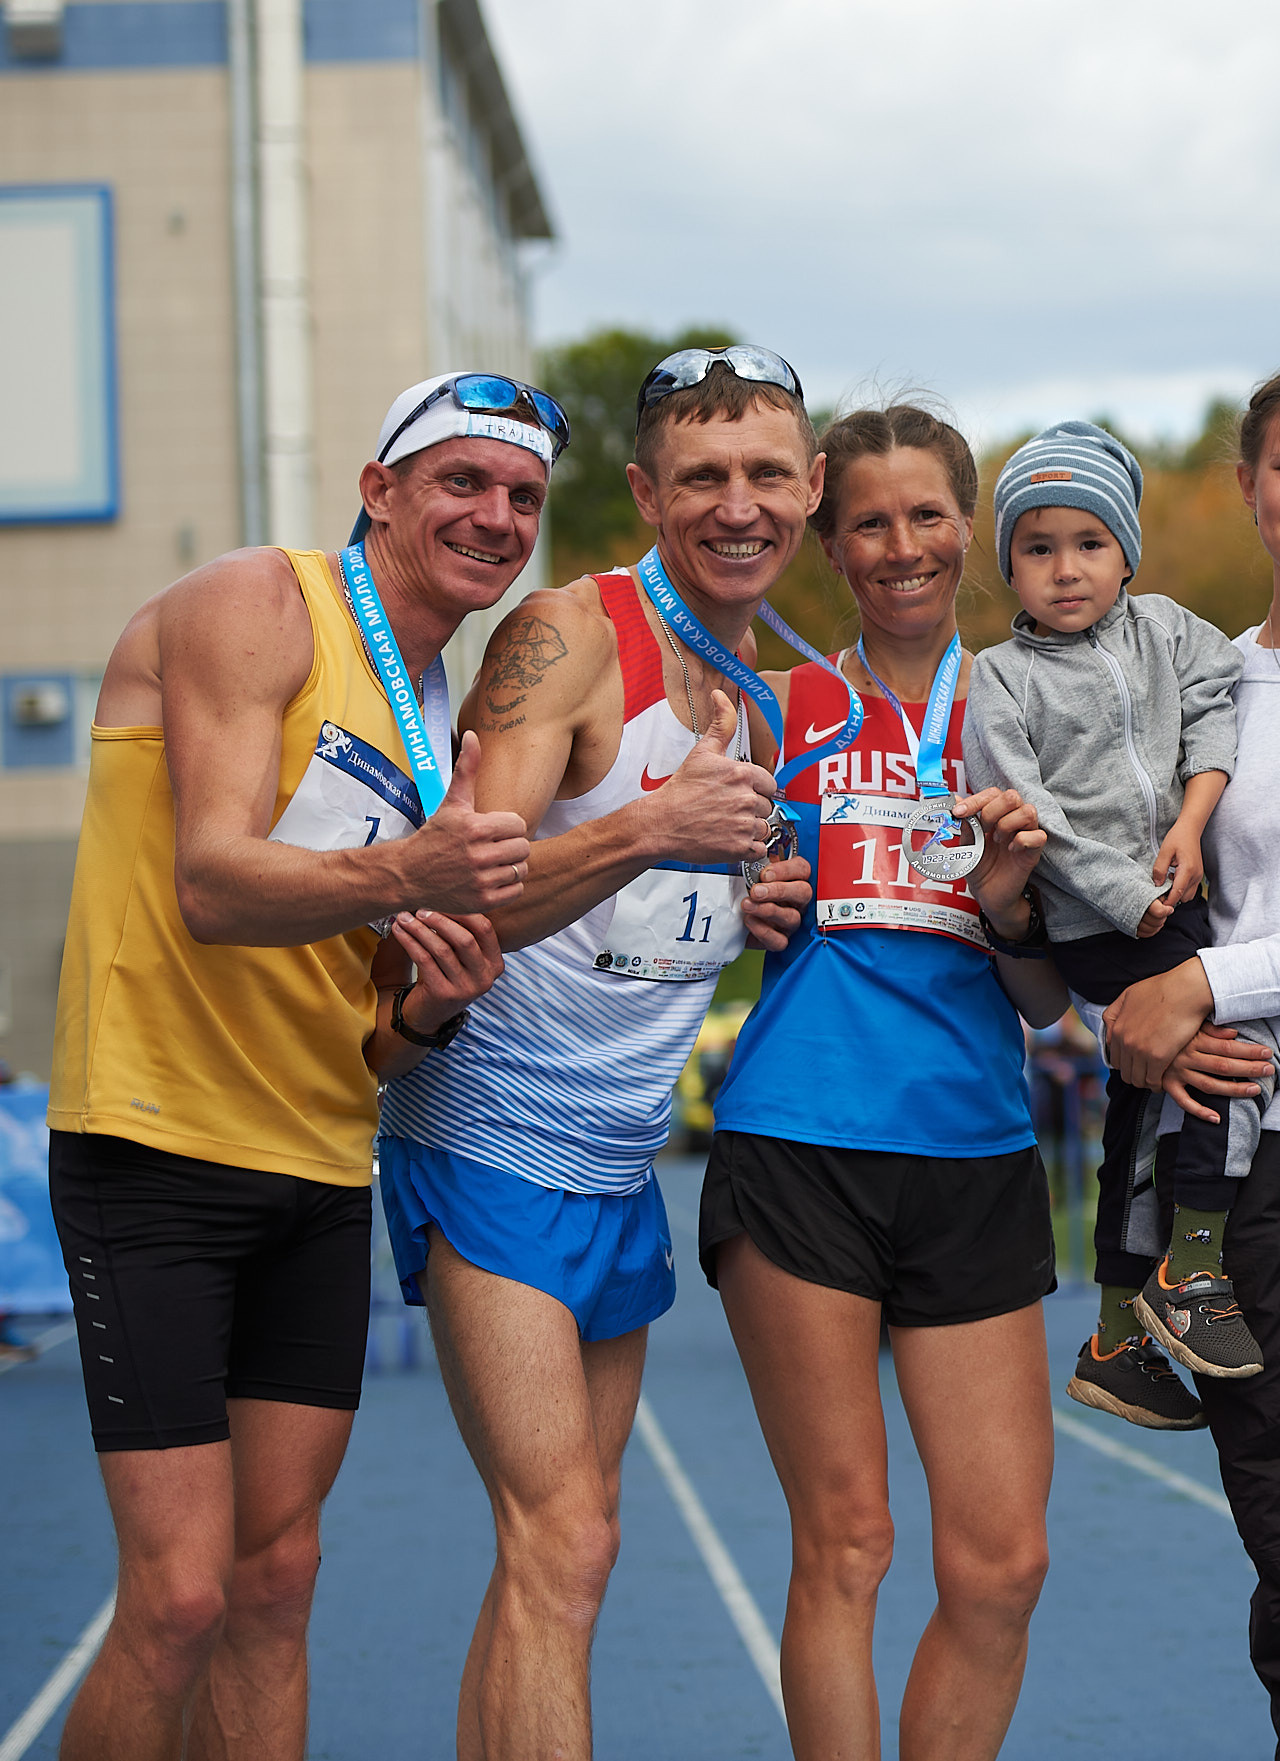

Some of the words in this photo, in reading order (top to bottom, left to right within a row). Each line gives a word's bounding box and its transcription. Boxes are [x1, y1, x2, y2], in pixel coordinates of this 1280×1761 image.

[485, 424, 535, 443] TRAIL
[1035, 472, 1066, 480] SPORT
[353, 572, 382, 627] МИЛЯ
[645, 566, 677, 612] МИЛЯ
[672, 611, 774, 701] ДИНАМОВСКАЯ
[372, 629, 437, 771] ДИНАМОВСКАЯ
[927, 682, 948, 745] ДИНАМОВСКАЯ
[347, 750, 402, 798] Динамовская
[922, 851, 973, 865] 1923-2023
[130, 1098, 160, 1115] RUN
